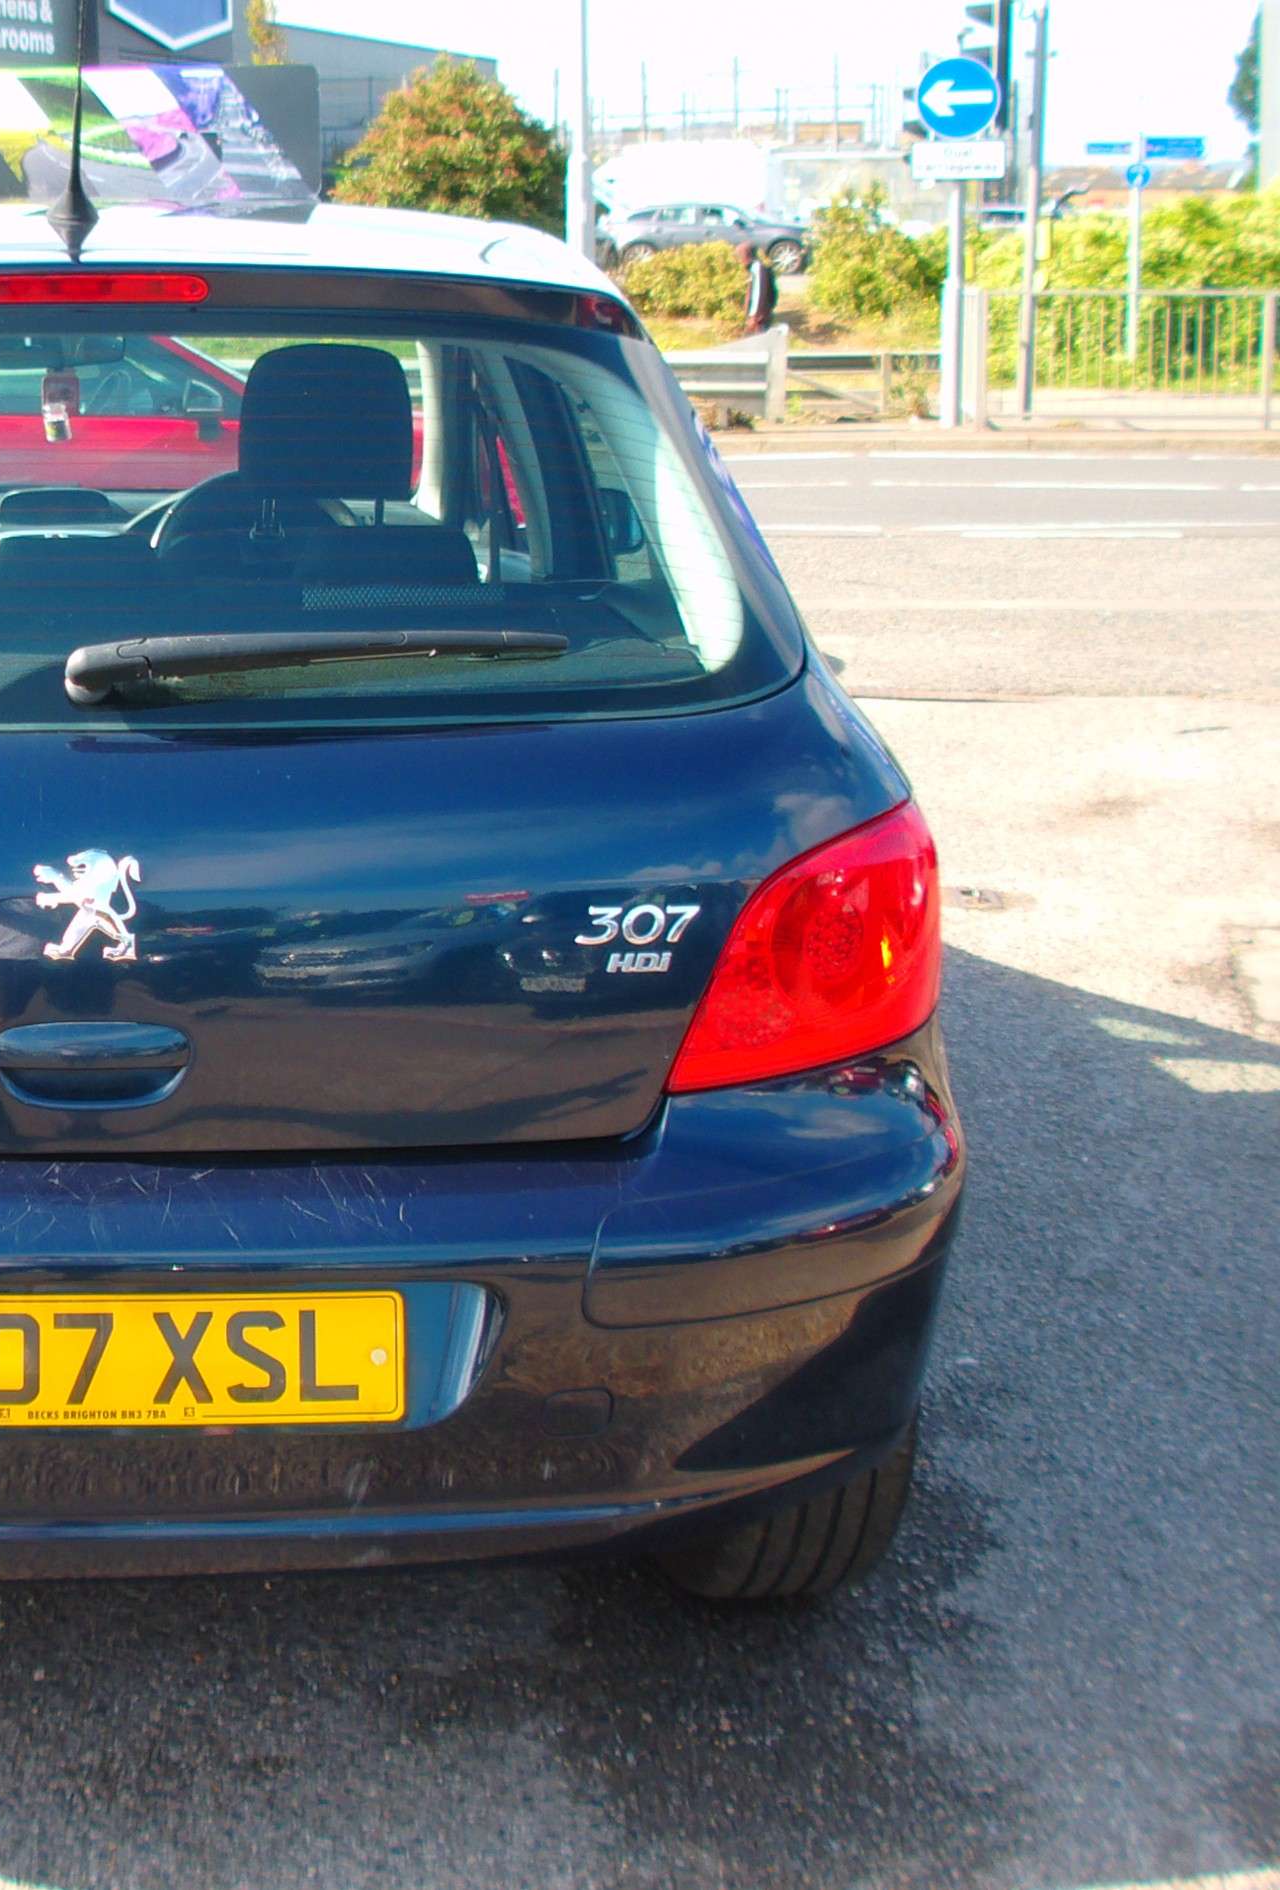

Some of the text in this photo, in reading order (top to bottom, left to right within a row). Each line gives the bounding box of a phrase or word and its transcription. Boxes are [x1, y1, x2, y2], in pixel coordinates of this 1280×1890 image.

[574, 904, 700, 945] 307
[152, 1310, 360, 1404] XSL
[27, 1410, 60, 1420] BECKS
[63, 1410, 117, 1420] BRIGHTON
[146, 1409, 167, 1419] 7BA
